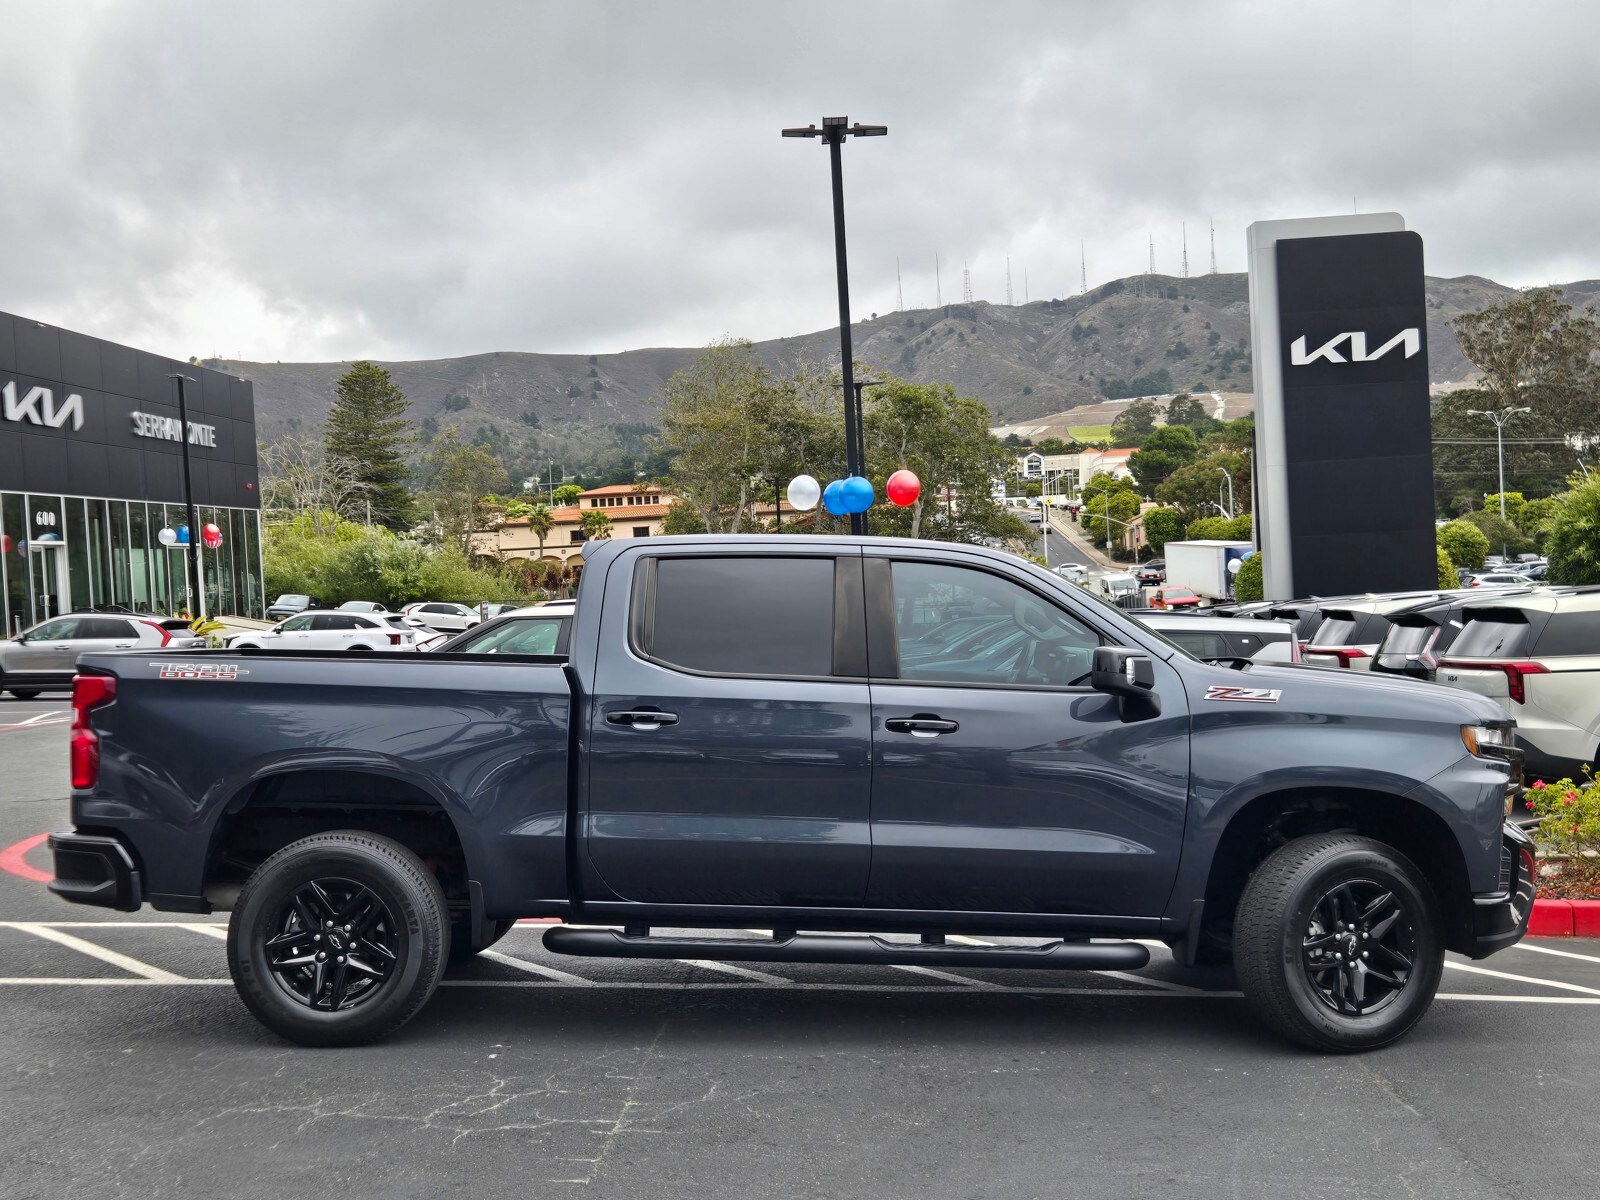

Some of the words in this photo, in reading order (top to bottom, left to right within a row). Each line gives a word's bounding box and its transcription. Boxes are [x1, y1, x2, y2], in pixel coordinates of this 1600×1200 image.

[1290, 328, 1420, 366] KIA
[2, 380, 84, 432] KIA
[35, 511, 56, 526] 600
[149, 662, 250, 674] TRAIL
[160, 671, 237, 680] BOSS
[1203, 685, 1283, 703] Z71
